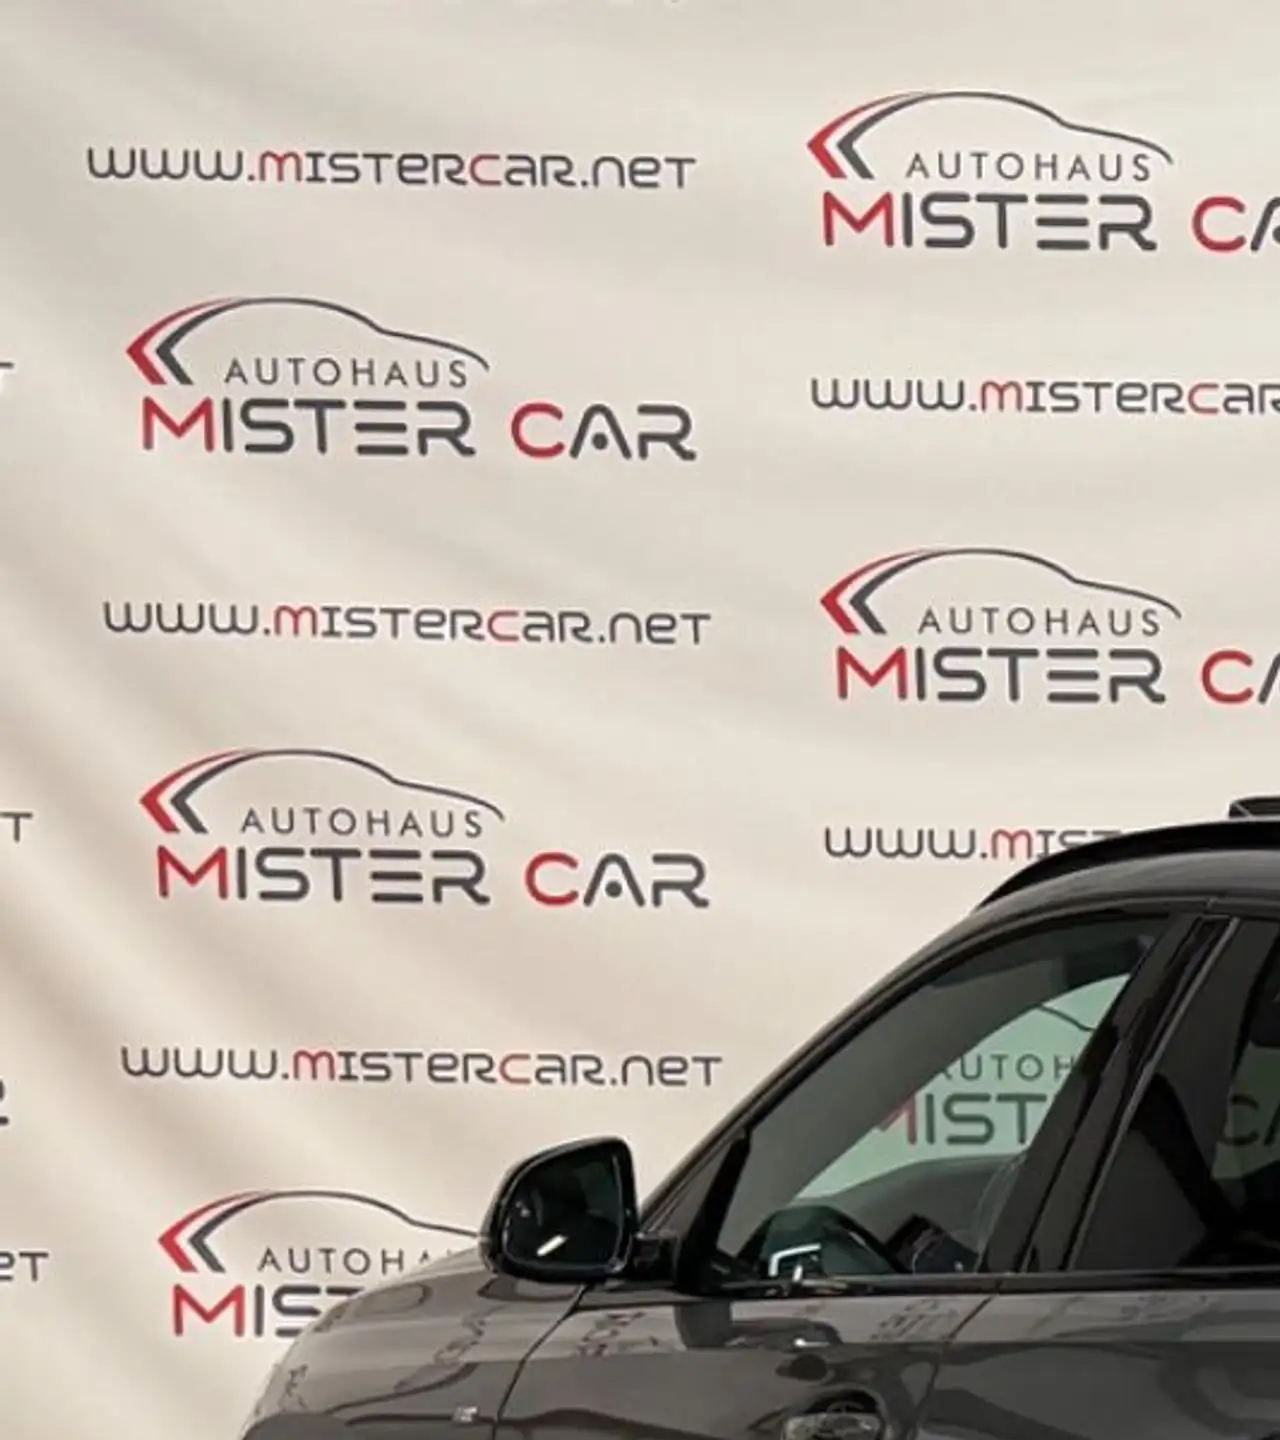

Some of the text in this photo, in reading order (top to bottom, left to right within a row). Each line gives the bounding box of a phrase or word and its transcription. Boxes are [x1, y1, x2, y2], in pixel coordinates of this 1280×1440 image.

[905, 150, 1152, 182] AUTOHAUS
[821, 189, 1159, 253] MISTER
[223, 356, 469, 389] AUTOHAUS
[140, 394, 698, 463] MISTER CAR
[917, 606, 1161, 637] AUTOHAUS
[834, 644, 1168, 706] MISTER
[240, 805, 483, 839] AUTOHAUS
[155, 843, 711, 910] MISTER CAR
[940, 1052, 1074, 1082] UTOH
